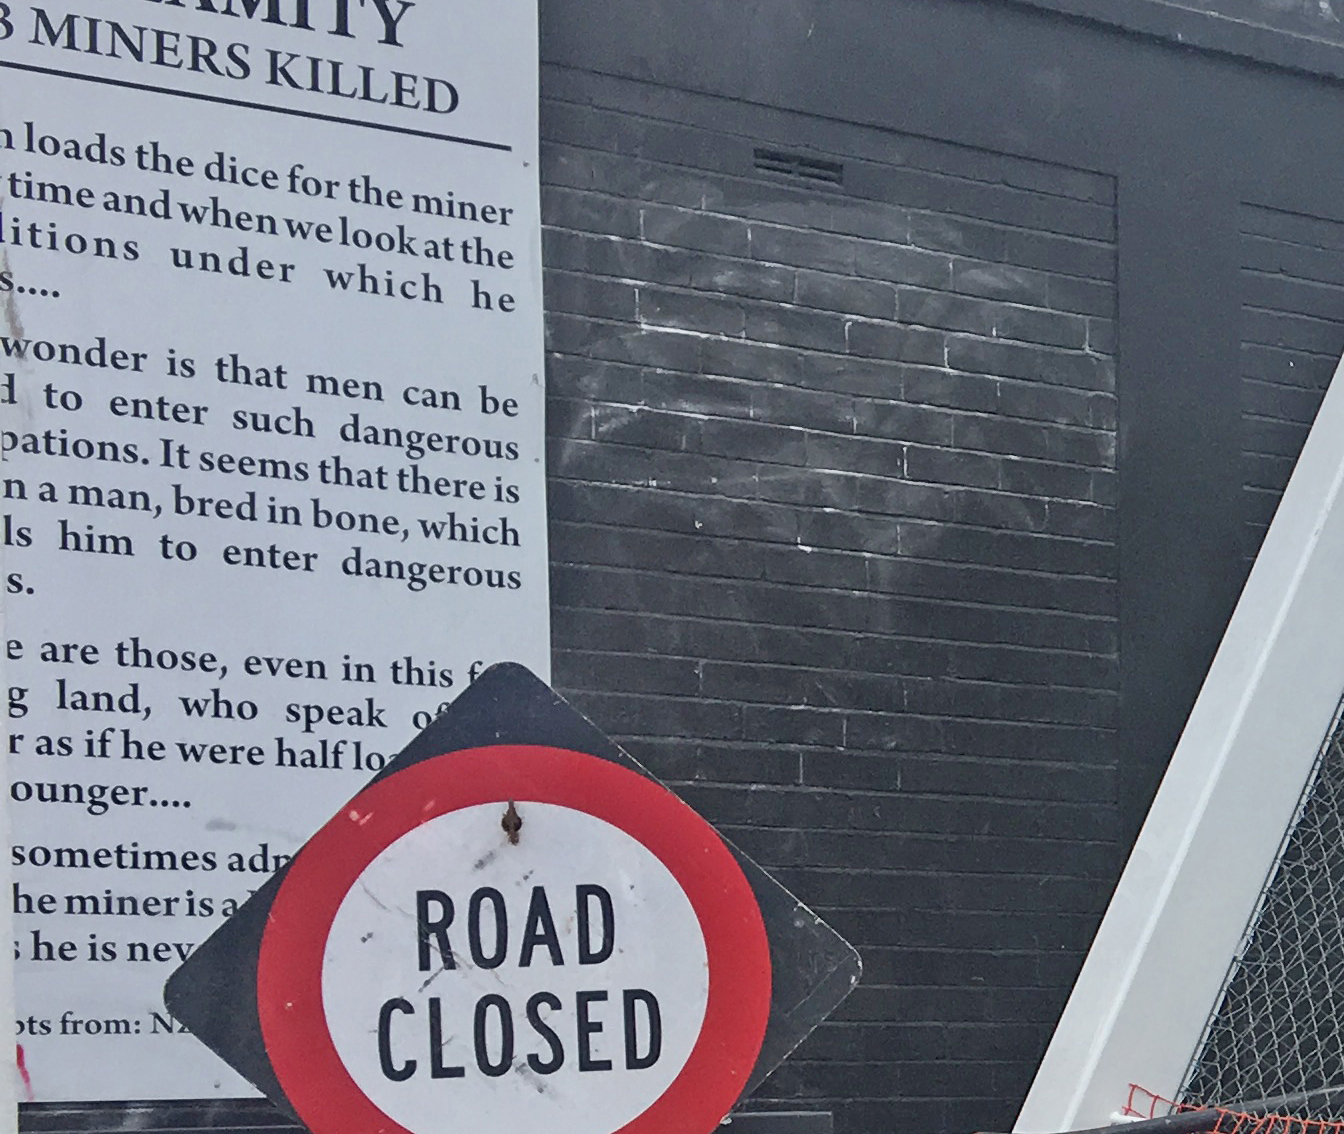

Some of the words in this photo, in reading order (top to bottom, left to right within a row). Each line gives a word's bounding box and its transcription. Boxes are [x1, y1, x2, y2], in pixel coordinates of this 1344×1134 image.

[28, 6, 253, 81] MINERS
[265, 48, 459, 114] KILLED
[24, 121, 126, 167] loads
[134, 141, 195, 177] the
[204, 151, 279, 190] dice
[287, 163, 341, 199] for
[347, 175, 404, 209] the
[412, 191, 514, 226] miner
[7, 171, 95, 209] time
[102, 189, 173, 220] and
[176, 196, 280, 236] when
[283, 218, 333, 244] we
[338, 216, 419, 257] look
[424, 237, 455, 262] at
[461, 236, 514, 270] the
[0, 211, 140, 261] itions
[169, 246, 296, 283] under
[323, 263, 444, 304] which
[471, 279, 515, 313] he
[0, 336, 148, 373] wonder
[166, 348, 196, 379] is
[214, 353, 288, 390] that
[306, 374, 384, 402] men
[402, 386, 462, 411] can
[478, 384, 519, 418] be
[43, 382, 83, 412] to
[109, 396, 209, 426] enter
[232, 406, 316, 438] such
[339, 413, 519, 461] dangerous
[1, 428, 150, 466] pations.
[159, 438, 191, 470] It
[199, 451, 310, 482] seems
[317, 455, 388, 491] that
[396, 464, 486, 501] there
[494, 476, 520, 504] is
[2, 478, 28, 501] n
[38, 481, 59, 503] a
[68, 485, 162, 519] man,
[171, 483, 258, 522] bred
[267, 496, 303, 527] in
[310, 497, 409, 543] bone,
[417, 511, 521, 547] which
[3, 514, 33, 548] ls
[57, 519, 135, 557] him
[159, 534, 197, 562] to
[222, 543, 319, 573] enter
[341, 546, 522, 592] dangerous
[6, 573, 35, 595] s.
[40, 642, 100, 665] are
[114, 636, 228, 680] those,
[244, 655, 328, 680] even
[341, 654, 376, 683] in
[390, 656, 454, 688] this
[8, 686, 29, 719] g
[56, 678, 152, 721] land,
[178, 687, 258, 721] who
[285, 697, 388, 734] speak
[9, 734, 25, 754] r
[35, 735, 73, 757] as
[84, 727, 116, 759] if
[120, 728, 166, 761] he
[174, 742, 265, 766] were
[274, 736, 348, 770] half
[353, 740, 398, 771] lo
[10, 781, 191, 816] ounger....
[11, 841, 218, 872] sometimes
[12, 882, 57, 915] he
[64, 889, 180, 917] miner
[185, 889, 215, 918] is
[416, 883, 616, 972] ROAD
[30, 929, 78, 962] he
[87, 933, 117, 962] is
[59, 1010, 141, 1035] from:
[378, 988, 662, 1082] CLOSED
